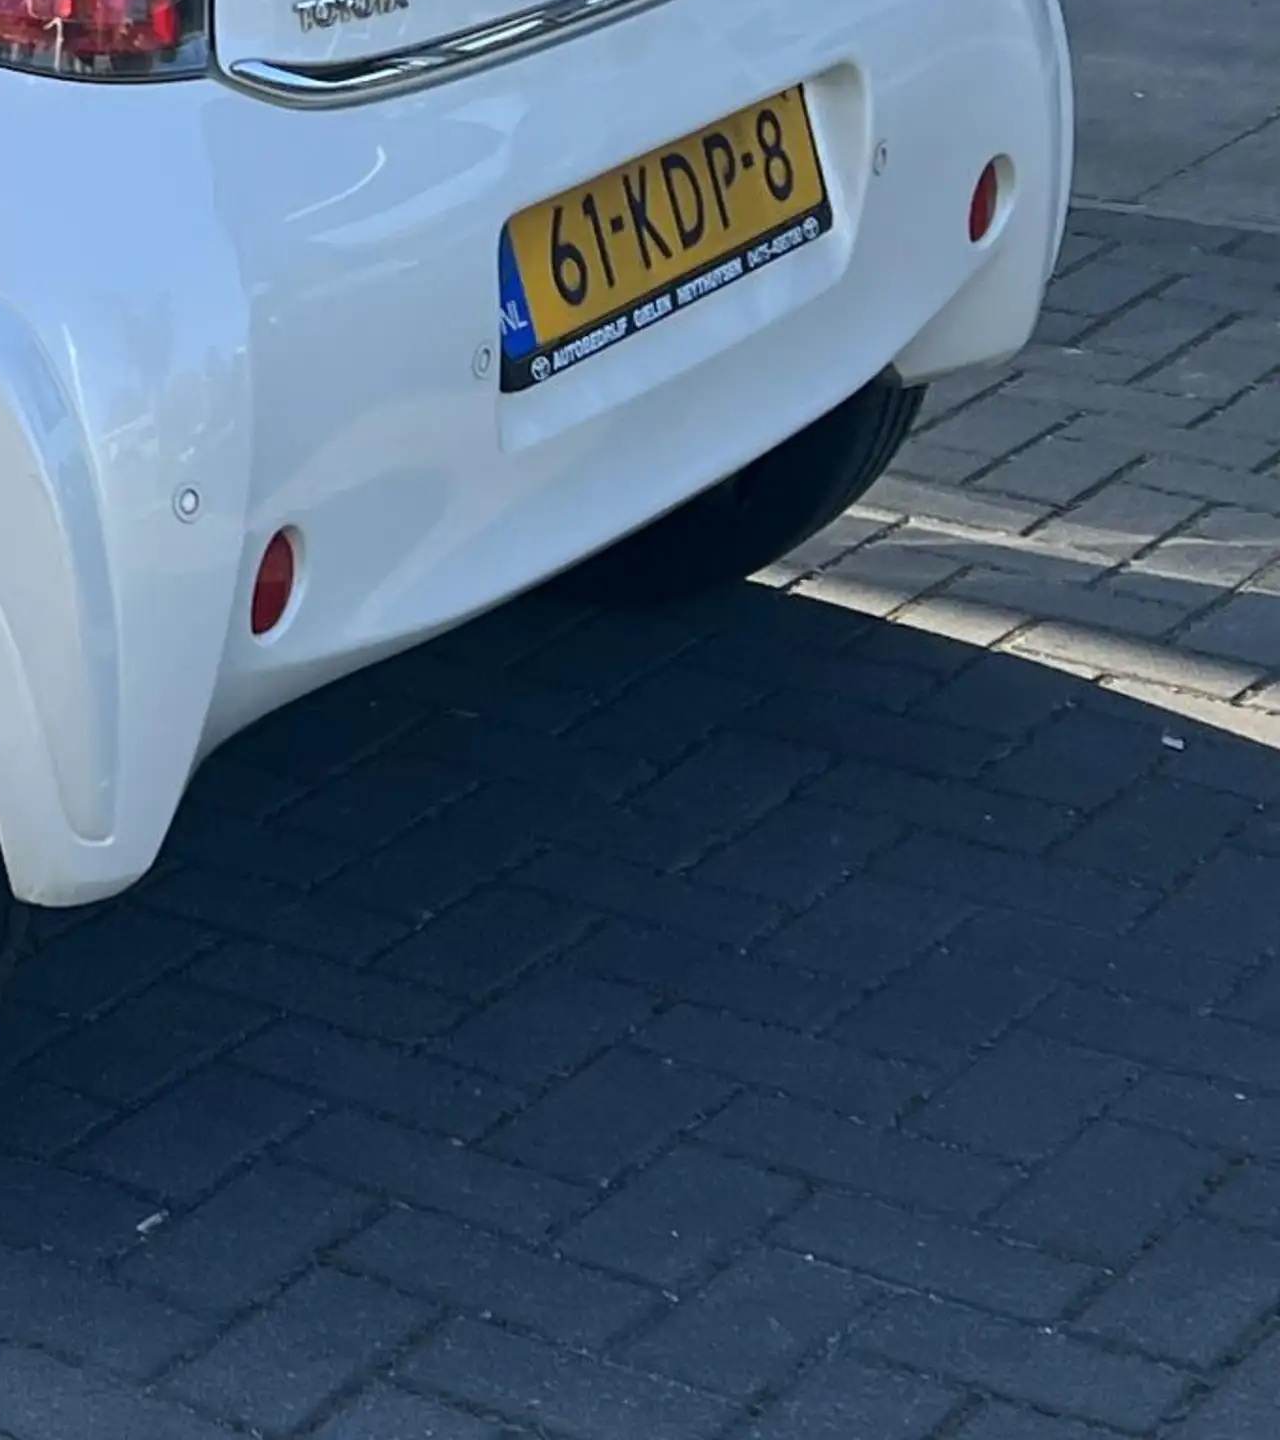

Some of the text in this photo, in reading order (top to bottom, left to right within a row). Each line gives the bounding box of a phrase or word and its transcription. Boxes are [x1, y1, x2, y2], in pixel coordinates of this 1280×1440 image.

[549, 107, 794, 307] 61-KDP-8
[499, 299, 529, 336] NL
[551, 315, 628, 371] AUTOBEDRIJF
